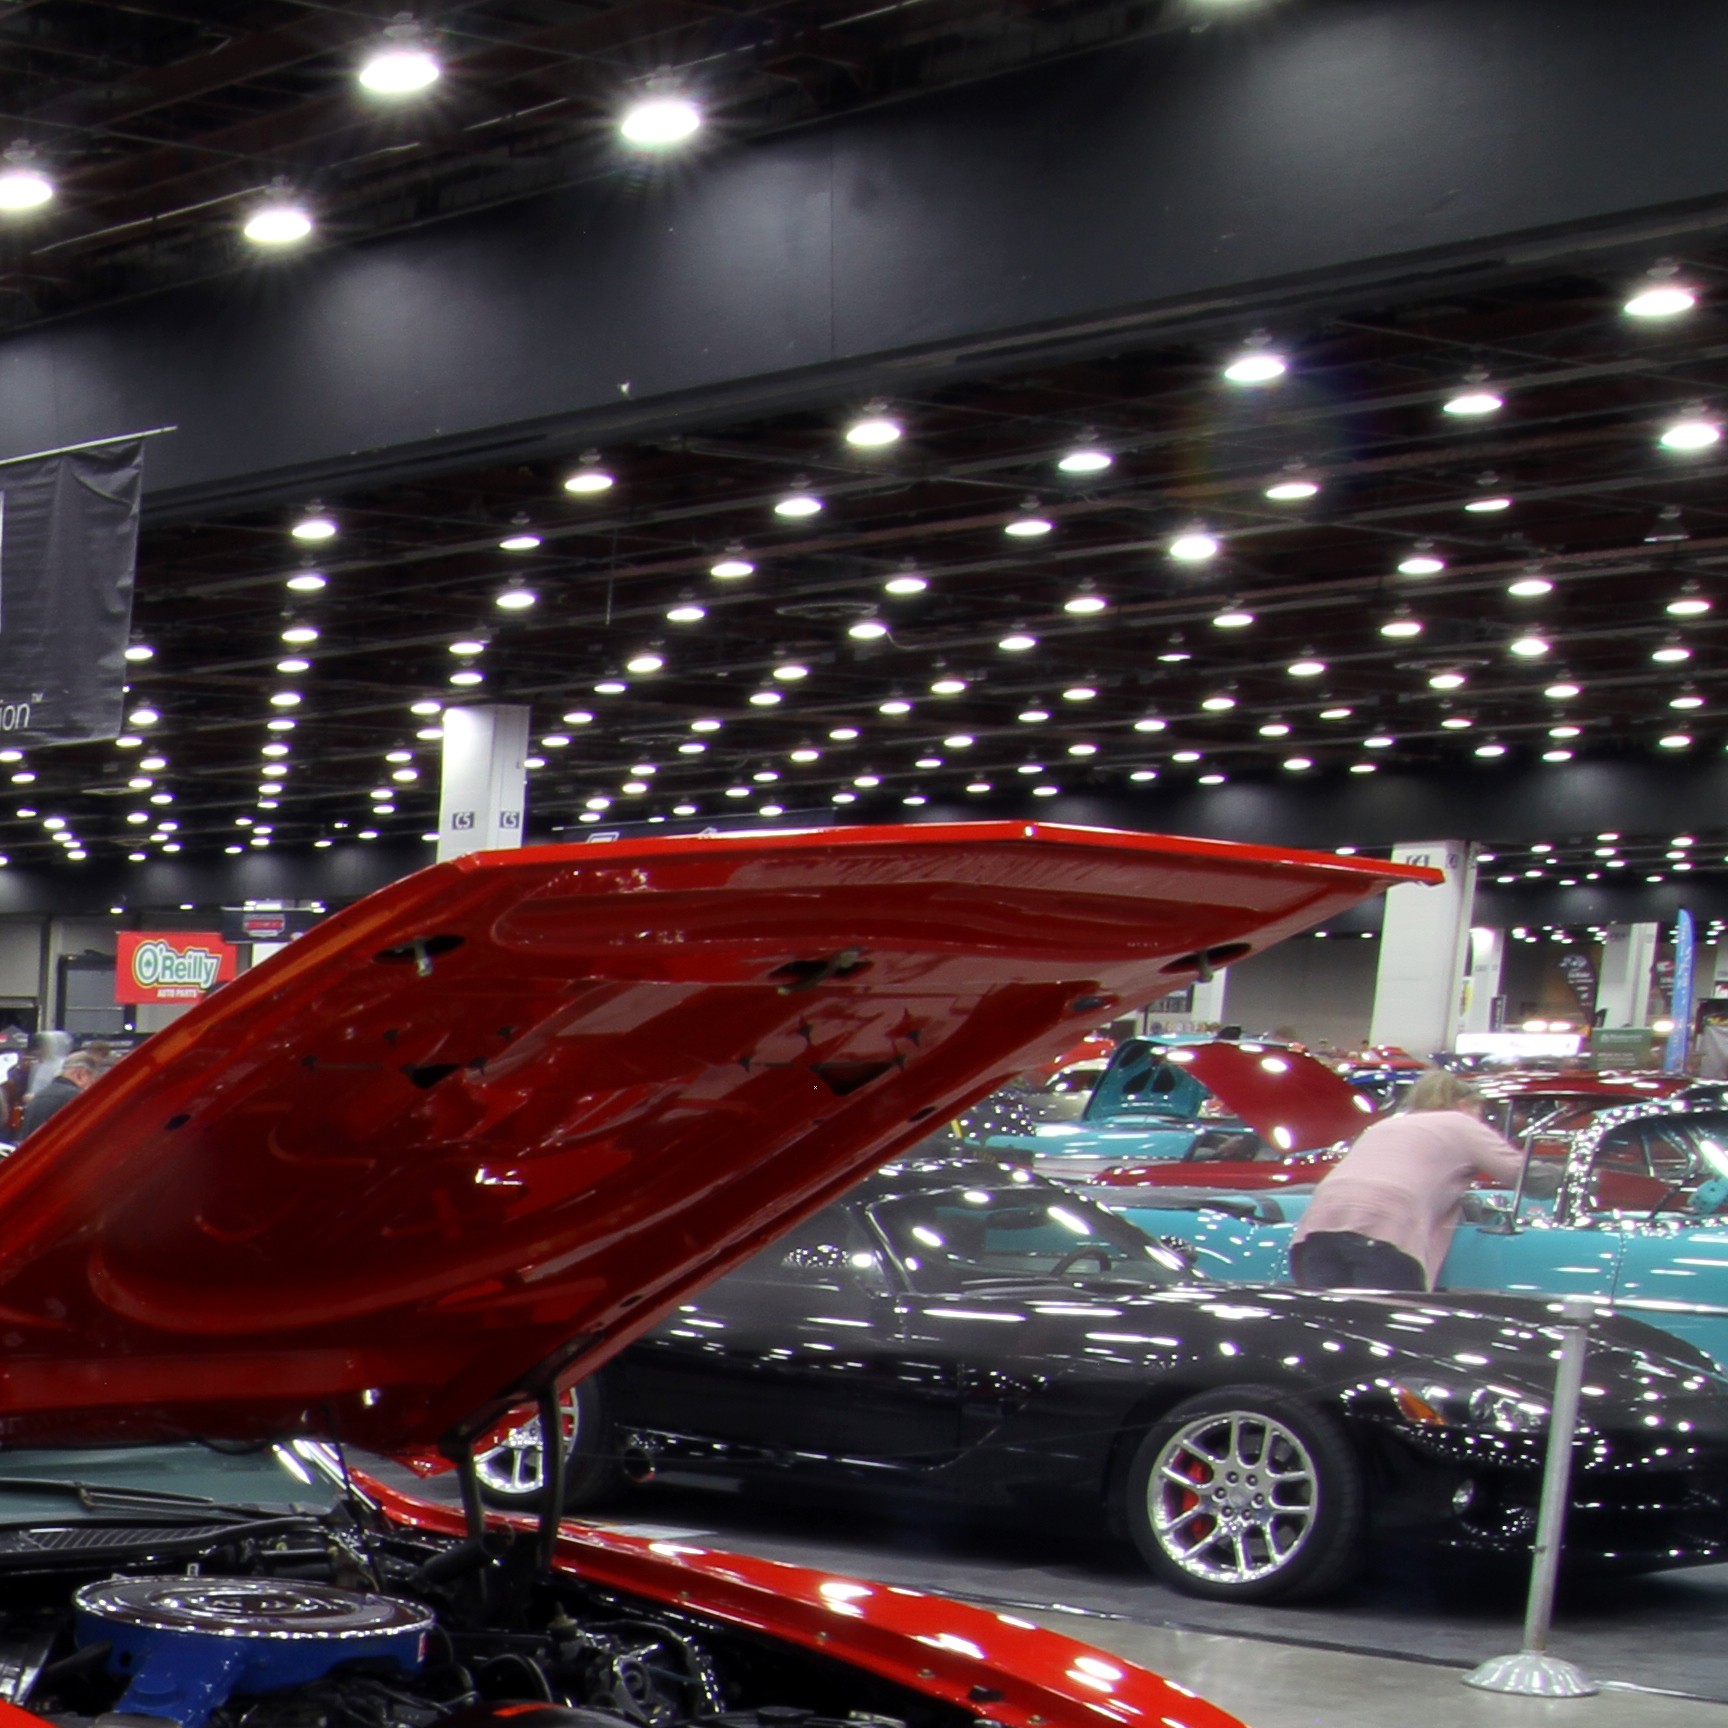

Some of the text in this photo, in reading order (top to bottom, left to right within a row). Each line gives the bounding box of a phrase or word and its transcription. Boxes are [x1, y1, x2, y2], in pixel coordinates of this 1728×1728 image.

[137, 943, 219, 988] O'Reilly
[157, 988, 198, 998] AUTO PARTS
